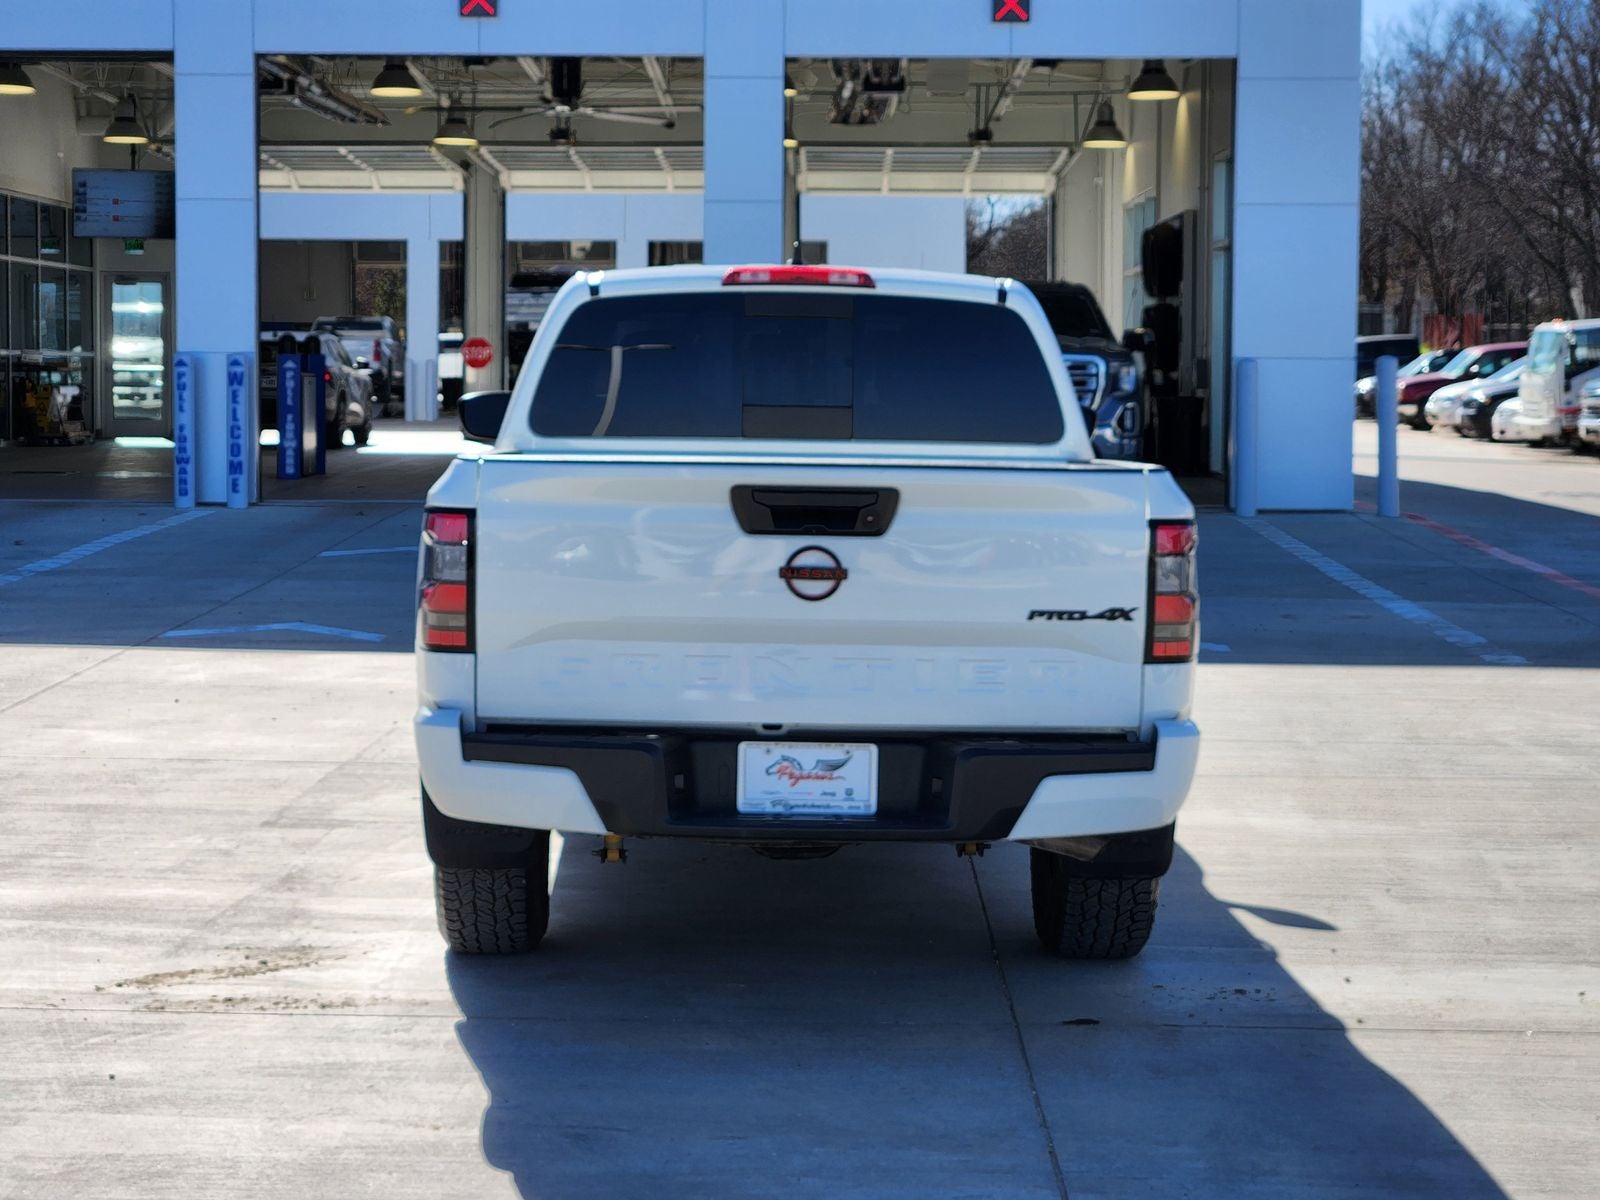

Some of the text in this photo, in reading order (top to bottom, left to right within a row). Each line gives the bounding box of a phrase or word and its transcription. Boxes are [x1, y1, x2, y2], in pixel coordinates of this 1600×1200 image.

[464, 346, 491, 359] STOP
[176, 372, 187, 412] PULL
[228, 371, 244, 493] WELCOME
[781, 568, 845, 578] NISSAN
